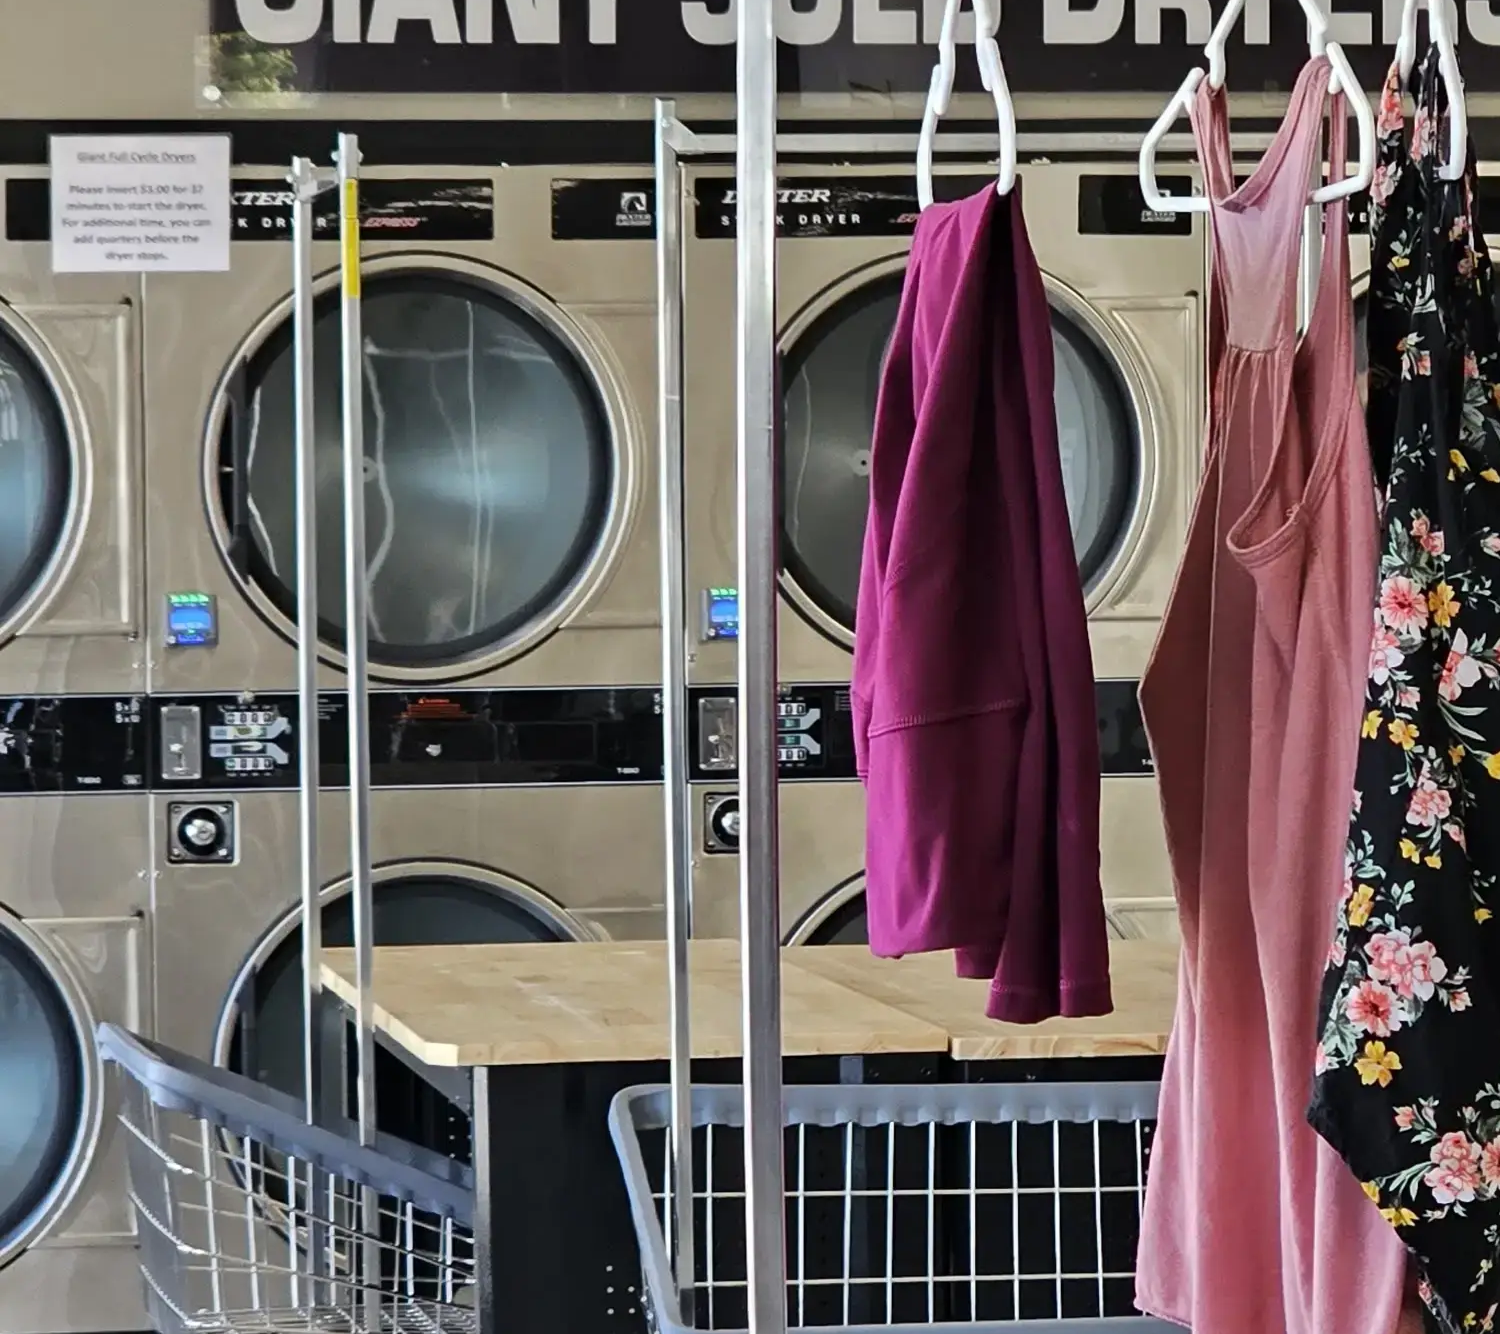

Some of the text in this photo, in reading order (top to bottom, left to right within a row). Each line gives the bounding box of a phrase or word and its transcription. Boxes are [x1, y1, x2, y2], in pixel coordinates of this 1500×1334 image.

[721, 189, 830, 204] DTER
[261, 217, 326, 228] DRR
[799, 214, 861, 224] DRYER
